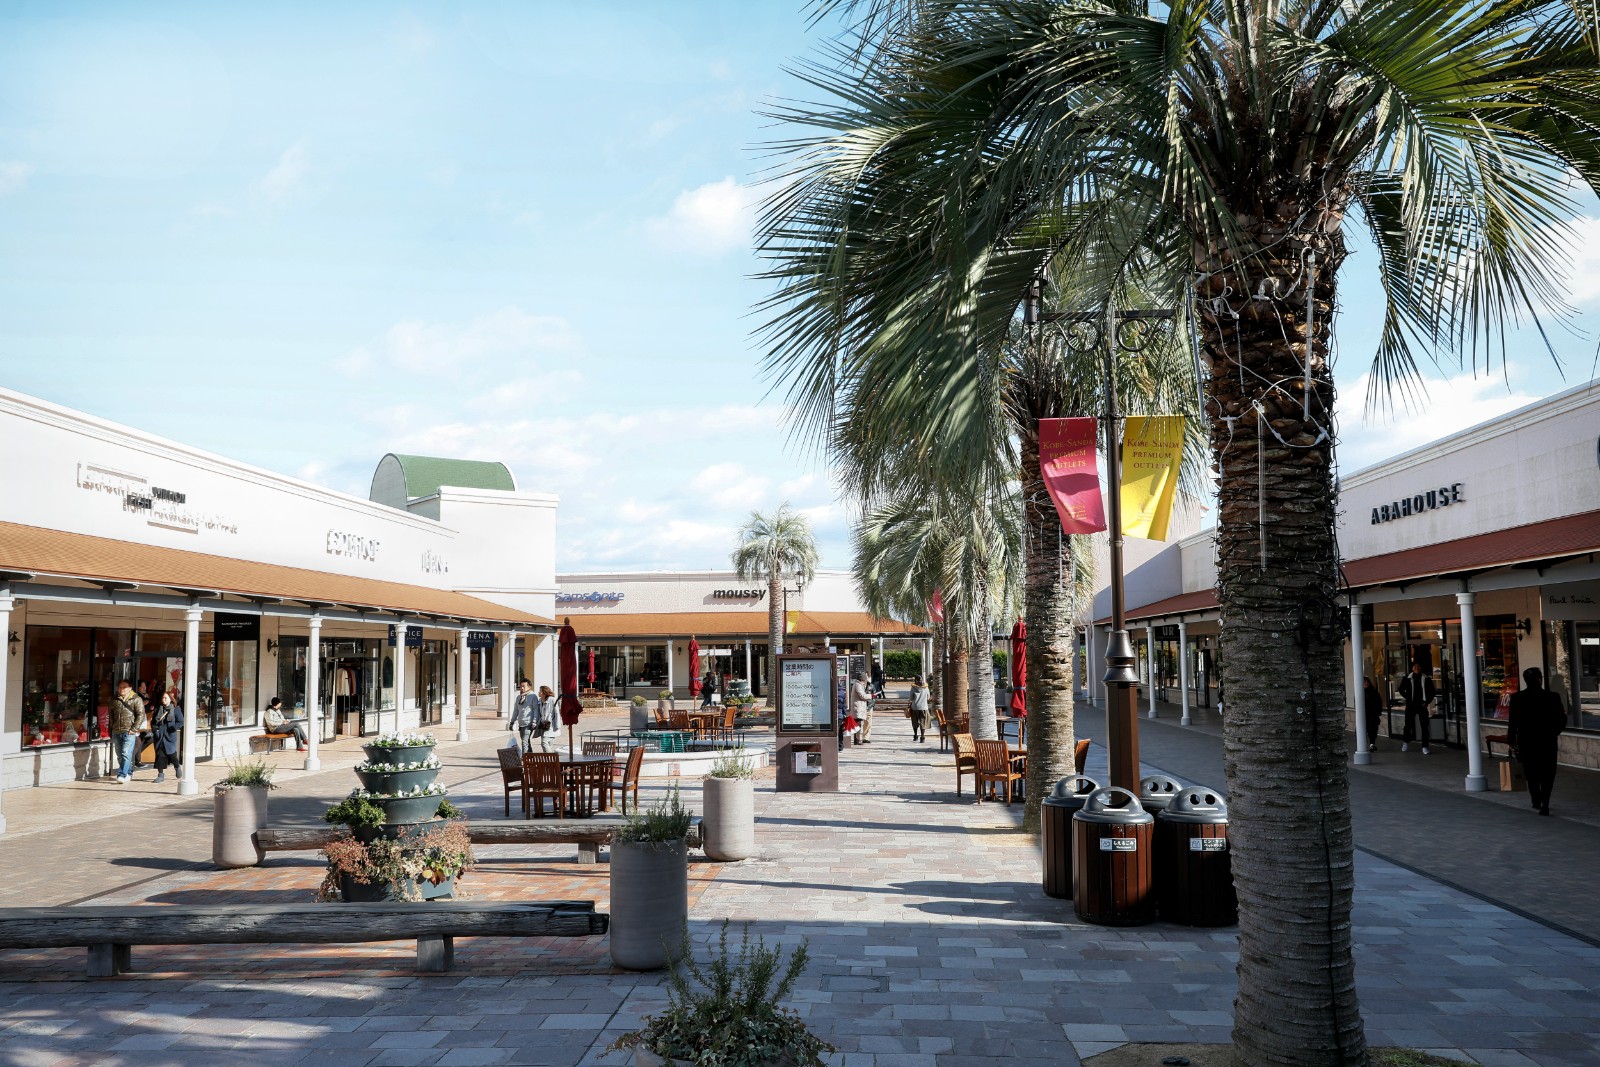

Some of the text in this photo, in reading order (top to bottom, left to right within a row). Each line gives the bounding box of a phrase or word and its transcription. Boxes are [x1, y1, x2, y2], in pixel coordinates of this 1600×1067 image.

[1049, 449, 1086, 459] PREMIUM
[1132, 451, 1171, 459] PREMIUM
[1051, 460, 1086, 470] OUTLETS
[1371, 482, 1465, 525] ABAHOUSE
[713, 589, 766, 600] moussy
